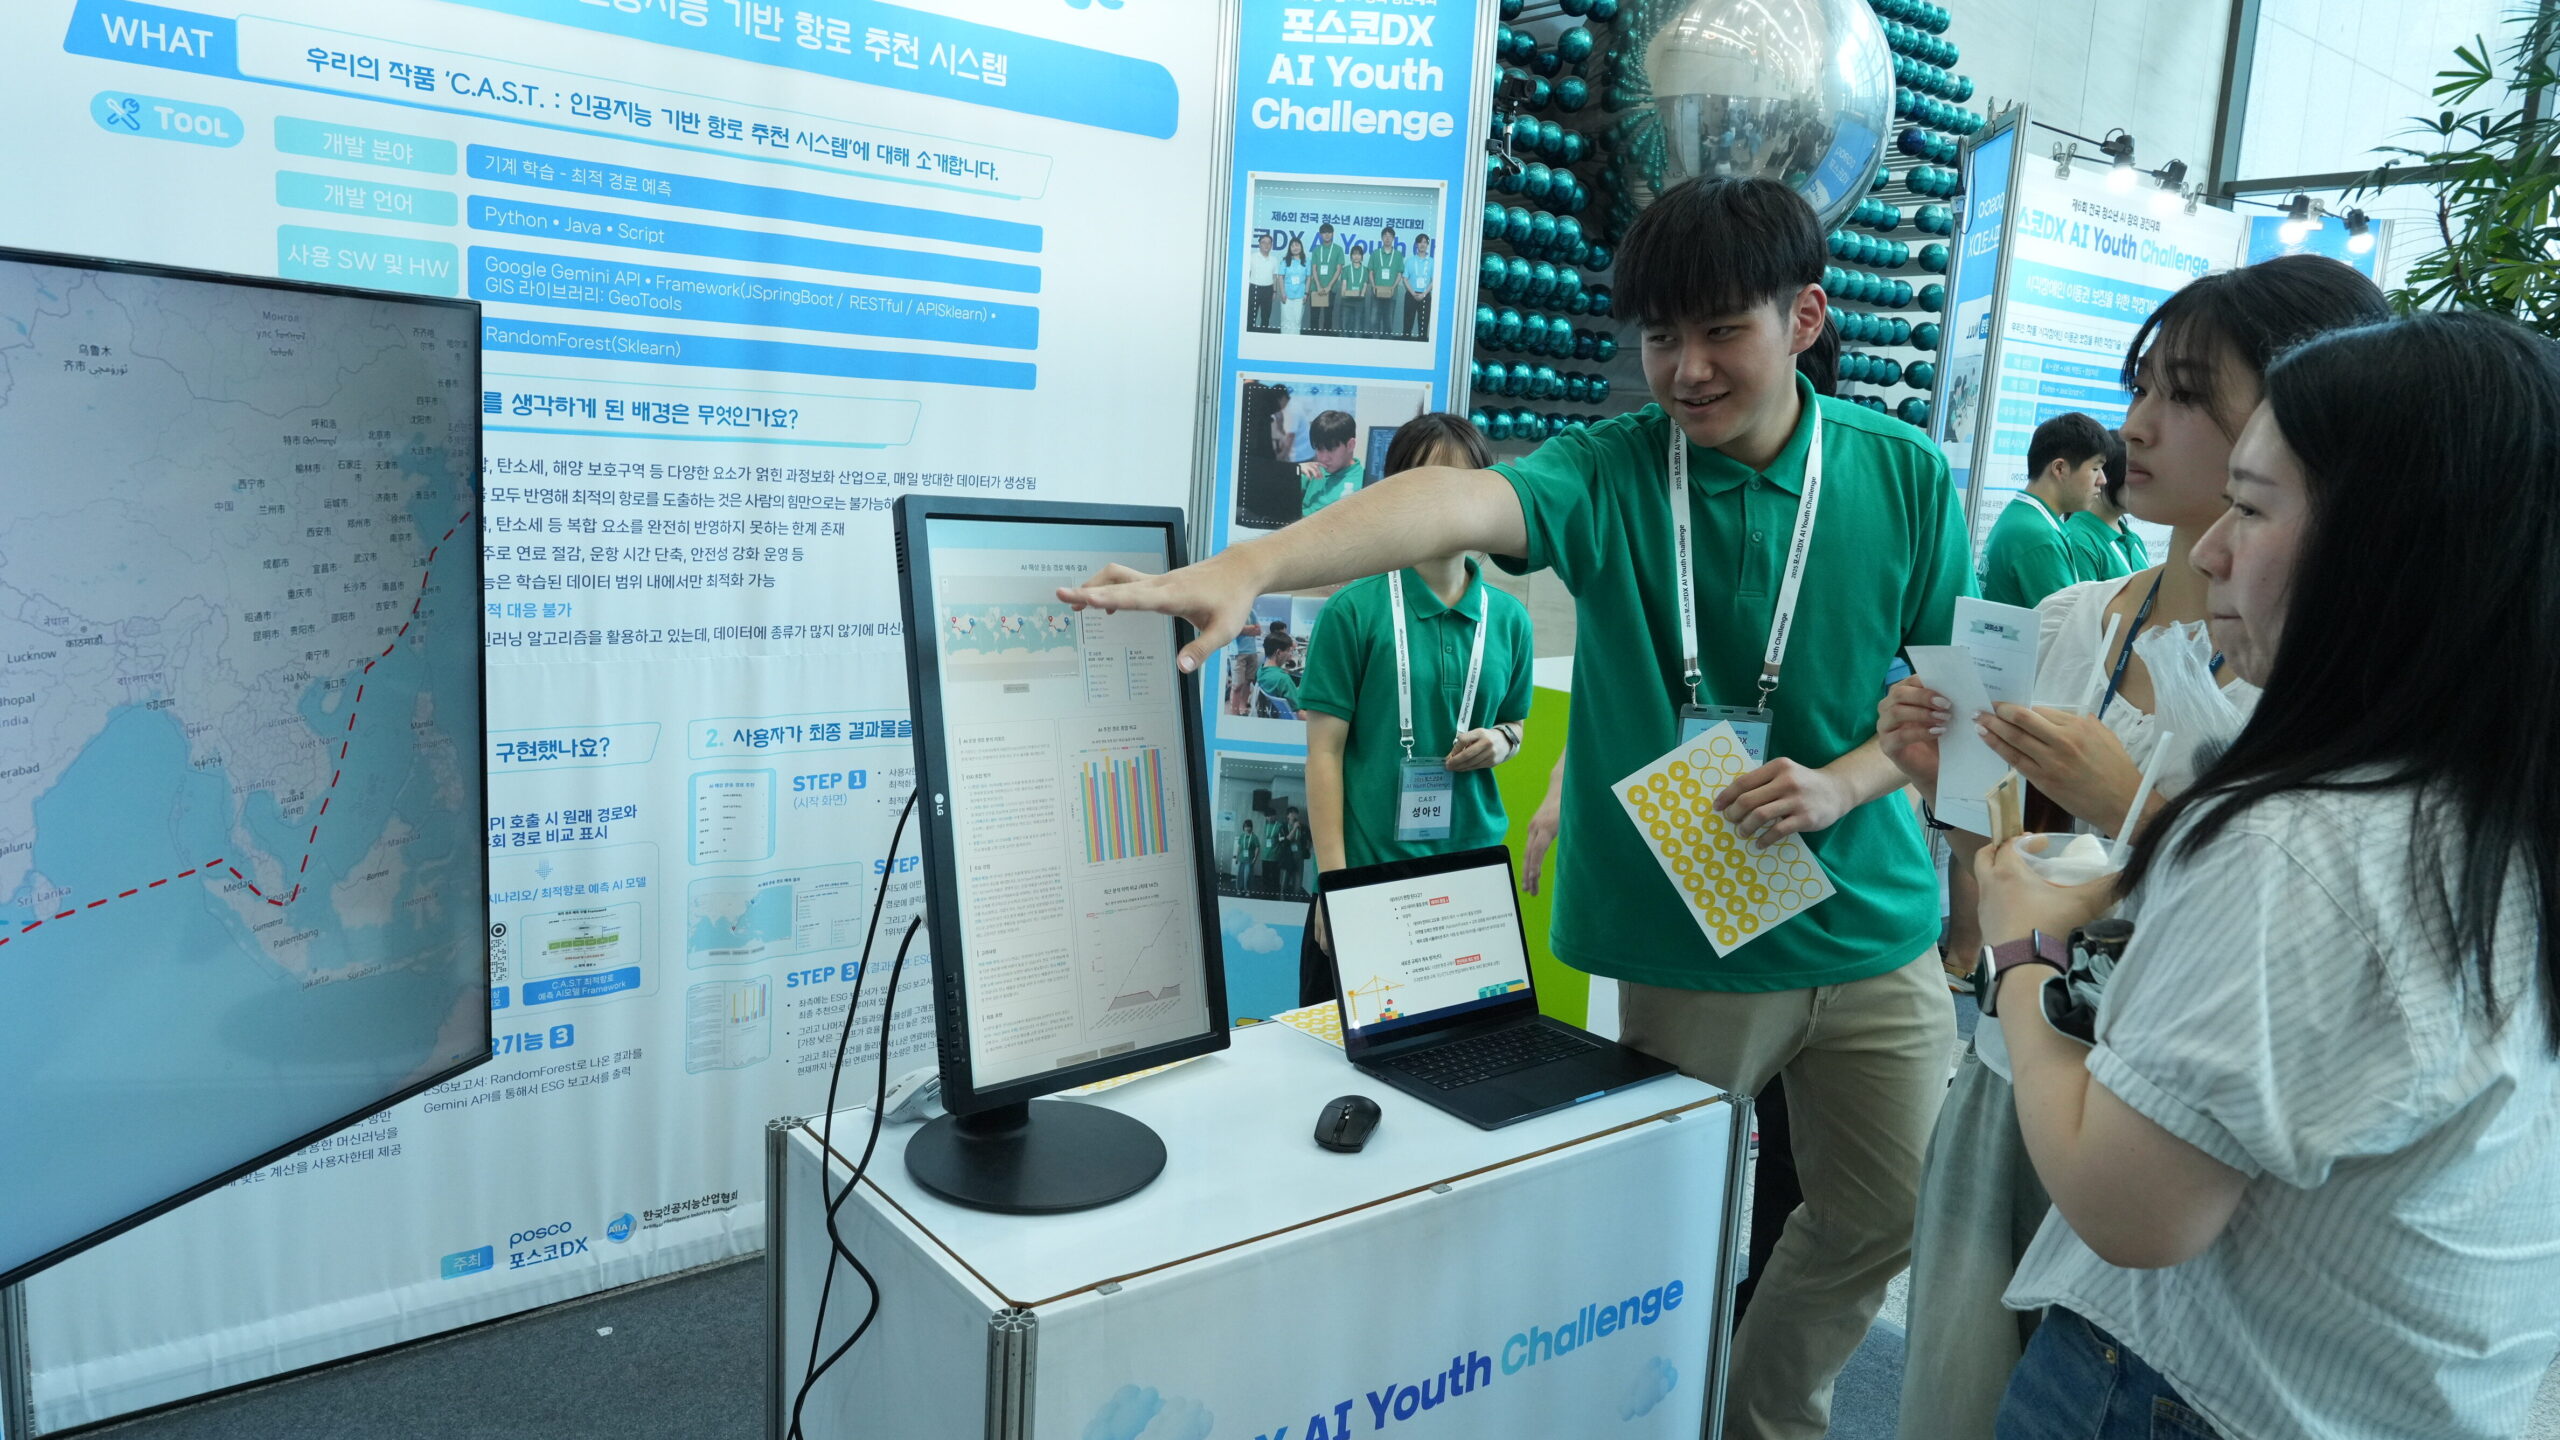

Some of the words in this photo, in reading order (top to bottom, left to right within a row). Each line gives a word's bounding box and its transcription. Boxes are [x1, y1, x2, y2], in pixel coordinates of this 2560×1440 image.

[101, 13, 214, 59] WHAT
[1282, 8, 1436, 47] 포스코DX
[724, 0, 784, 42] 기반
[795, 12, 851, 54] 항로
[864, 28, 919, 70] 추천
[930, 42, 1008, 87] 시스템
[1267, 53, 1316, 87] AI
[1326, 55, 1445, 92] Youth
[154, 105, 230, 140] TOOL
[306, 47, 380, 81] 우리의
[389, 61, 436, 92] 작품
[570, 92, 652, 127] 인공지능
[662, 108, 701, 135] 기반
[707, 115, 743, 142] 항로
[751, 122, 790, 149] 추천
[877, 144, 910, 168] 대해
[915, 150, 1000, 182] 소개합니다.
[1251, 97, 1455, 142] Challenge
[323, 132, 366, 157] 개발
[371, 139, 414, 165] 분야
[484, 154, 517, 177] 기계
[523, 159, 555, 182] 학습
[570, 166, 603, 189] 최적
[608, 171, 639, 193] 경로
[642, 176, 673, 198] 예측
[323, 183, 367, 208] 개발
[376, 189, 414, 215] 언어
[485, 205, 548, 233] Python
[564, 215, 602, 236] Java
[618, 222, 665, 245] Script
[1272, 210, 1298, 223] 제6회
[1300, 212, 1319, 224] 전국
[1322, 213, 1351, 225] 청소년
[1353, 215, 1383, 228] AI창의
[1386, 217, 1424, 230] 경진대회
[287, 243, 331, 268] 사용
[338, 250, 377, 273] SW
[384, 252, 404, 275] 및
[409, 258, 450, 279] HW
[2069, 221, 2090, 249] AI
[2094, 226, 2137, 260] Youth
[2140, 239, 2210, 278] Challenge
[485, 255, 547, 279] Google
[551, 262, 611, 284] Gemini
[615, 268, 641, 287] API
[655, 275, 834, 309] Framework(JSpringBoot
[849, 294, 903, 314] RESTful
[485, 276, 515, 295] GIS
[519, 279, 604, 303] 라이브러리:
[608, 287, 683, 312] GeoTools
[262, 310, 300, 323] Монгол
[486, 326, 682, 359] RandomForest(Sklearn)
[512, 392, 597, 419] 생각하게
[604, 399, 625, 421] 된
[631, 401, 690, 425] 배경은
[698, 405, 799, 430] 무엇인가요?
[238, 478, 266, 490] 西宁市
[497, 457, 548, 477] 탄소세,
[552, 459, 583, 477] 해양
[587, 462, 645, 479] 보호구역
[667, 464, 710, 481] 다양한
[712, 466, 752, 482] 요소가
[786, 467, 835, 485] 과정보화
[838, 470, 890, 488] 산업으로,
[893, 470, 919, 487] 매일
[921, 472, 955, 488] 방대한
[956, 473, 1002, 490] 데이터가
[1004, 475, 1037, 491] 생성됨
[490, 488, 521, 504] 모두
[524, 488, 569, 505] 반영해
[572, 489, 616, 506] 최적의
[618, 490, 660, 508] 항로를
[662, 491, 715, 508] 도출하는
[745, 494, 785, 510] 사람의
[788, 494, 847, 511] 힘만으로는
[1805, 476, 1817, 510] Challenge
[258, 503, 286, 516] 兰州市
[1801, 509, 1811, 529] Youth
[306, 526, 332, 538] 西安市
[1799, 530, 1807, 538] AI
[262, 557, 290, 570] 成都市
[1680, 558, 1688, 578] Youth
[1791, 563, 1799, 579] 2025
[252, 629, 280, 642] 昆明市
[527, 630, 603, 647] 알고리즘을
[606, 628, 663, 645] 활용하고
[667, 628, 710, 643] 있는데,
[713, 625, 767, 641] 데이터에
[1774, 612, 1788, 646] Challenge
[7, 649, 57, 664] Lucknow
[305, 648, 330, 662] 南宁市
[733, 725, 803, 750] 사용자가
[809, 721, 842, 744] 최종
[848, 719, 913, 741] 결과물을
[495, 737, 611, 764] 구현했나요?
[793, 772, 842, 792] STEP
[793, 795, 820, 810] (시작
[821, 792, 848, 807] 화면)
[510, 813, 540, 830] 호출
[563, 809, 593, 825] 원래
[597, 804, 637, 823] 경로와
[387, 832, 421, 848] Malaysia
[511, 831, 542, 848] 경로
[546, 827, 575, 844] 비교
[579, 825, 609, 841] 표시
[17, 893, 34, 907] Sri
[37, 886, 72, 902] Lanka
[541, 883, 586, 899] 최적항로
[588, 881, 610, 895] 예측
[612, 880, 623, 891] AI
[625, 876, 647, 889] 모델
[401, 891, 439, 909] Indonesia
[251, 917, 284, 934] Sumatra
[272, 927, 319, 949] Palembang
[302, 974, 330, 993] Jakarta
[346, 964, 382, 982] Surabaya
[786, 966, 836, 988] STEP
[582, 980, 626, 995] Framework
[490, 1060, 588, 1085] RandomForest로
[589, 1055, 610, 1069] 나온
[613, 1048, 643, 1064] 결과를
[423, 1098, 468, 1114] Gemini
[471, 1089, 501, 1107] API를
[505, 1084, 538, 1100] 통해서
[541, 1079, 565, 1094] ESG
[567, 1070, 609, 1088] 보고서를
[612, 1066, 632, 1080] 출력
[336, 1126, 399, 1147] 머신러닝을
[312, 1150, 374, 1170] 사용자한테
[377, 1143, 402, 1158] 제공
[509, 1220, 572, 1249] posco
[453, 1252, 481, 1272] 주최
[509, 1236, 589, 1271] 포스코DX
[1302, 1399, 1353, 1440] AI
[1367, 1351, 1491, 1429] Youth
[1501, 1279, 1685, 1378] Challenge
